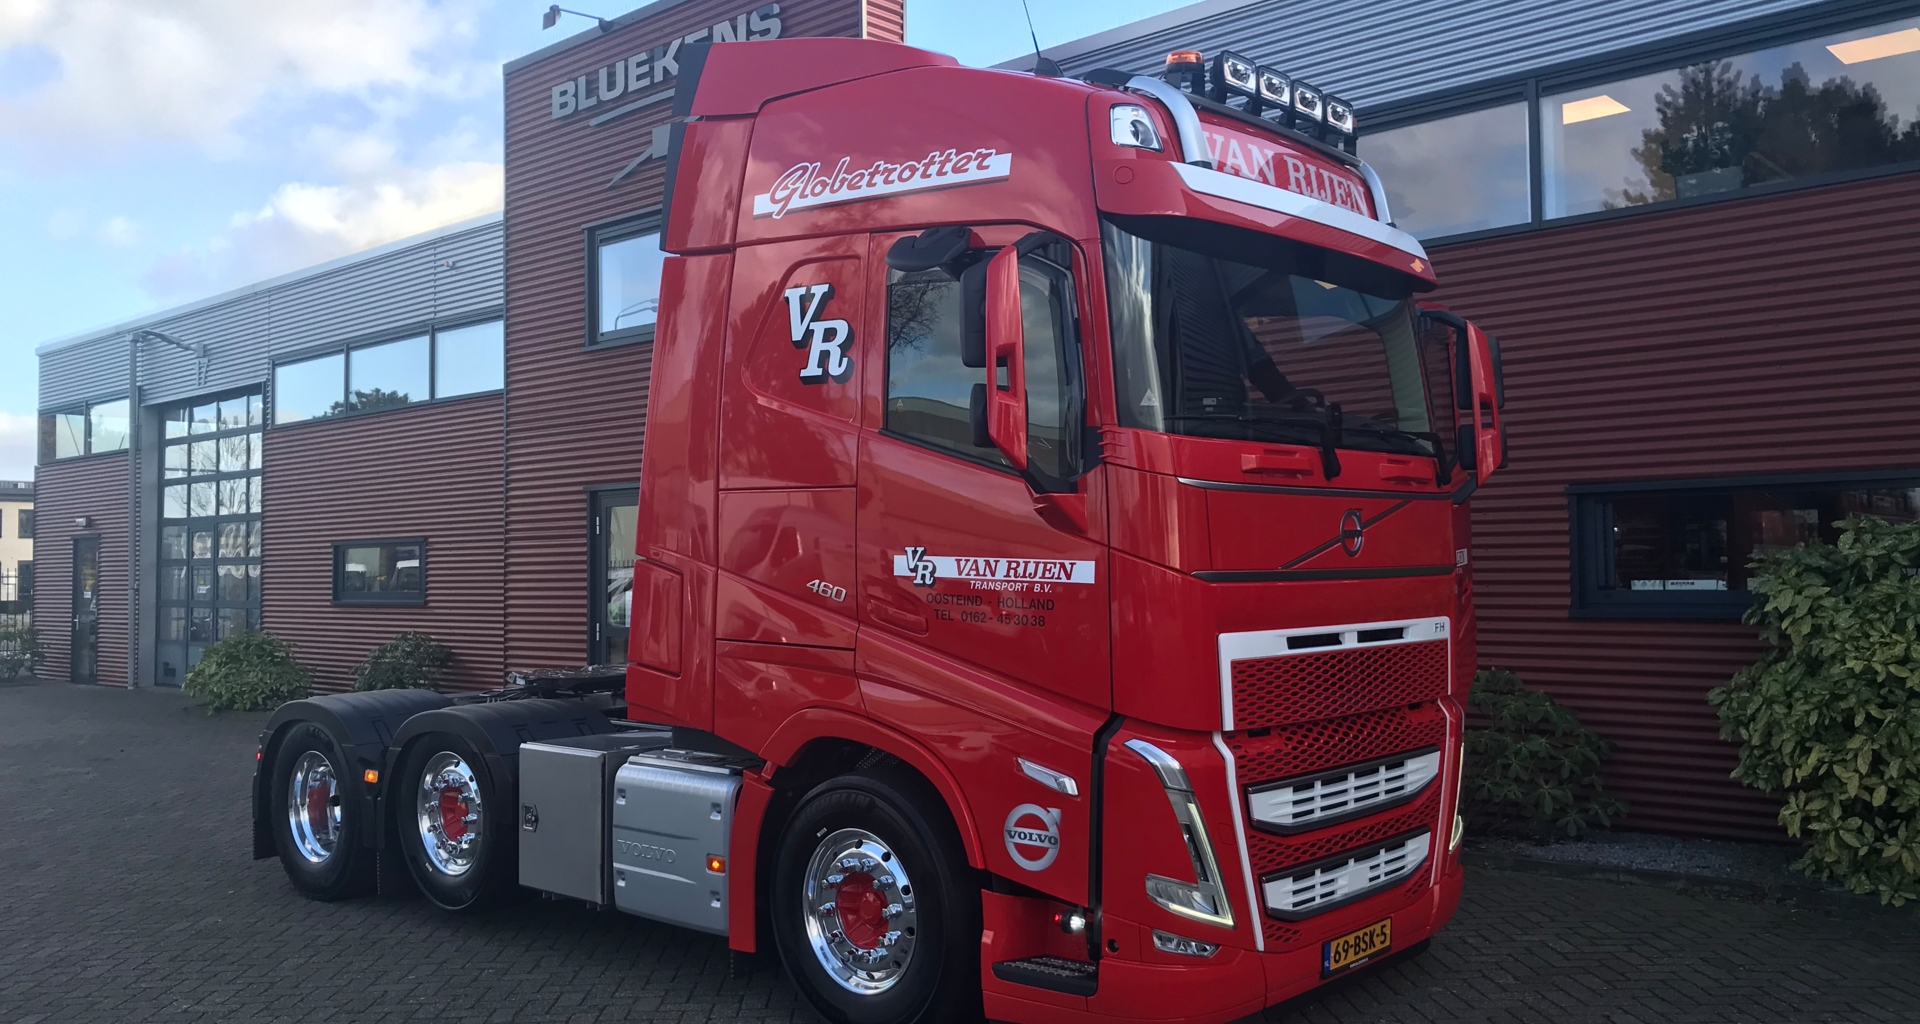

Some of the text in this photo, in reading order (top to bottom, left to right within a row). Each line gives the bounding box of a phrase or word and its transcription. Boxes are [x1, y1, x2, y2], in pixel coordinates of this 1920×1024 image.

[551, 3, 782, 120] BLUEKNS
[769, 148, 997, 219] Globetrotter
[1203, 132, 1371, 218] VAN RIJEN
[954, 558, 1077, 581] VAN RIJEN
[806, 579, 847, 603] 460
[969, 580, 1053, 593] TRANSPORT B.V.
[926, 592, 983, 607] OOSTEIND
[996, 598, 1055, 611] HOLLAND
[934, 609, 954, 622] TEL
[961, 611, 987, 624] 0162
[1434, 622, 1445, 633] FH
[1004, 829, 1059, 846] VOLVO
[617, 839, 677, 863] VOLVO
[1333, 923, 1387, 964] 69-BSK-5
